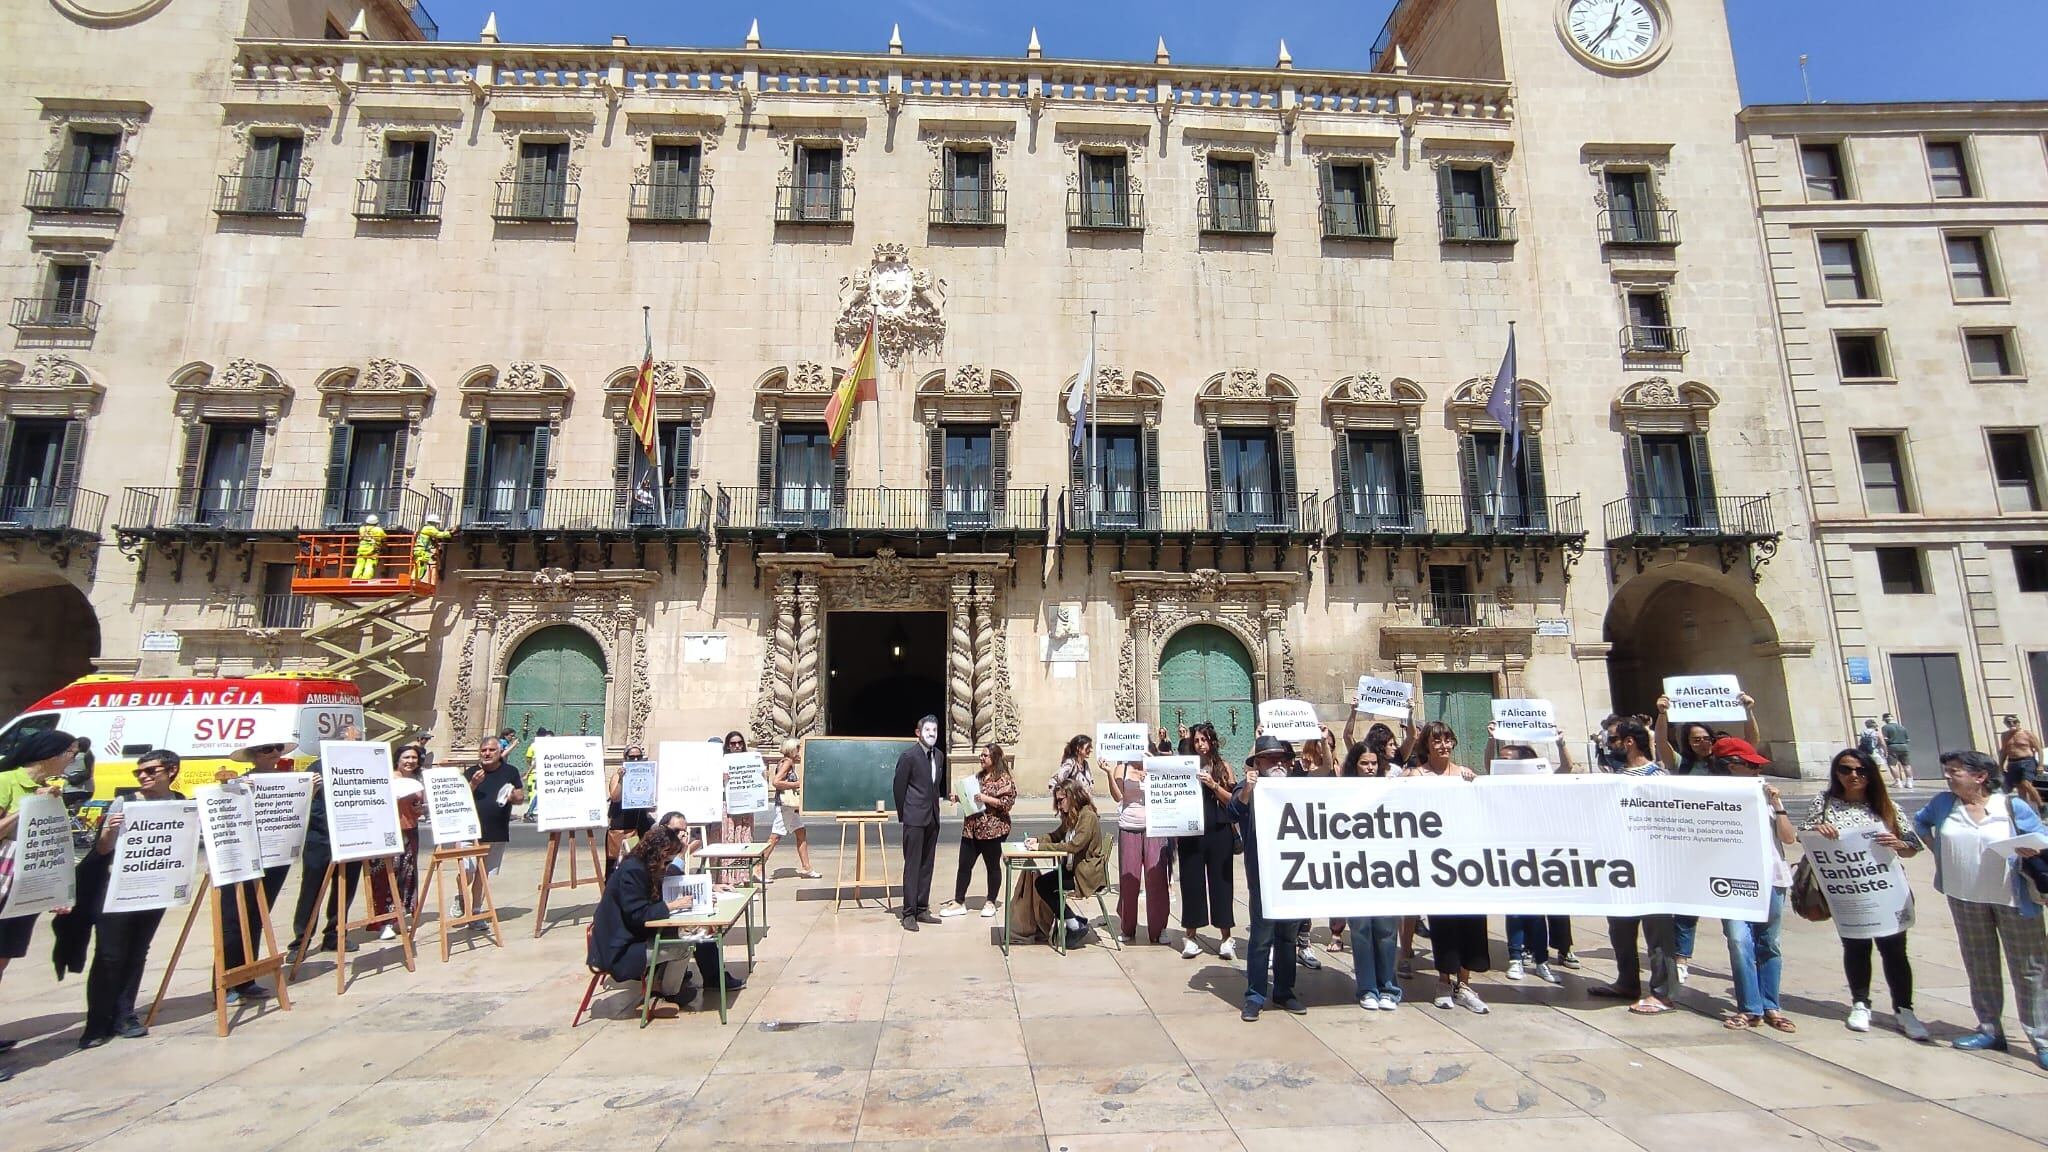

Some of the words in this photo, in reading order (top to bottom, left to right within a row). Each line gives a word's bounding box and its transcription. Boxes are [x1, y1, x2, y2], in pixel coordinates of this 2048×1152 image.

[1367, 686, 1404, 698] #Alicante
[1676, 686, 1730, 696] #Alicante
[88, 689, 264, 706] AMBULÀNCIA
[1671, 700, 1738, 708] TieneFaltas
[1501, 708, 1546, 716] #Alicante
[194, 718, 256, 740] SVB
[1496, 720, 1553, 728] TieneFaltas
[1104, 732, 1140, 740] #Alicante
[1100, 743, 1144, 751] TieneFaltas
[332, 766, 364, 775] Nuestro
[332, 777, 389, 786] Alluntamiento
[255, 791, 306, 800] Alluntamiento
[333, 786, 361, 797] cunple
[275, 800, 293, 808] jente
[1620, 798, 1742, 812] #AlicanteTieneFaltas
[128, 820, 184, 832] Alicante
[1277, 802, 1443, 840] Alicatne
[1654, 816, 1695, 825] solidaridad,
[1697, 818, 1742, 826] compromiso,
[28, 828, 38, 838] la
[1696, 827, 1724, 835] palabra
[26, 838, 39, 849] de
[126, 836, 142, 845] es
[147, 834, 172, 844] una
[1694, 836, 1744, 844] Ayuntamiento.
[124, 846, 171, 858] zuidad
[1813, 850, 1831, 864] El
[1836, 850, 1866, 864] Sur
[24, 862, 36, 871] en
[122, 859, 184, 872] solidáira.
[1280, 850, 1420, 890] Zuidad
[1430, 848, 1636, 888] Solidáira
[1820, 862, 1889, 880] tanbién
[1826, 878, 1894, 895] ecsiste.
[1732, 889, 1758, 898] ONGD
